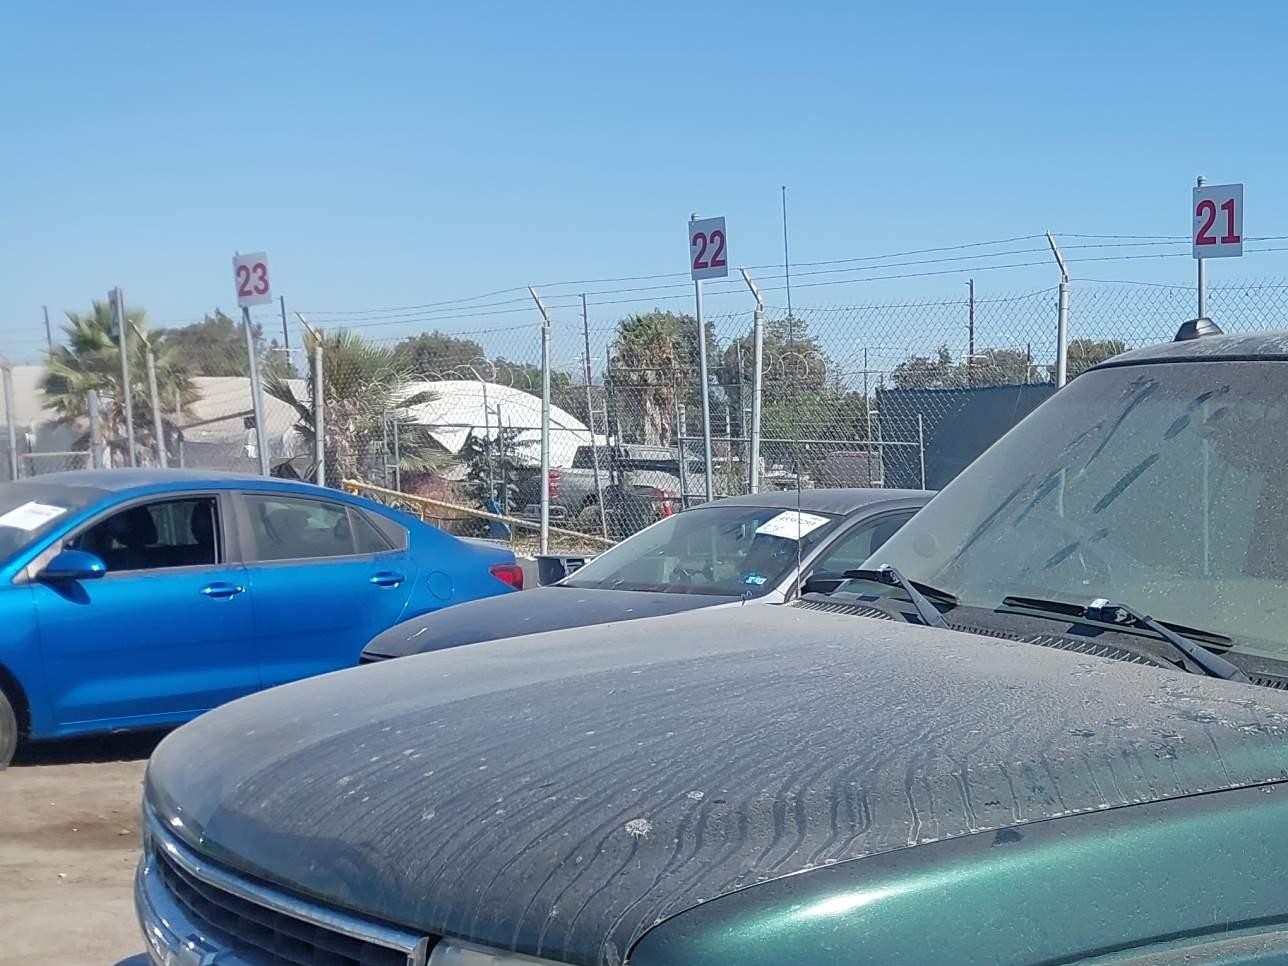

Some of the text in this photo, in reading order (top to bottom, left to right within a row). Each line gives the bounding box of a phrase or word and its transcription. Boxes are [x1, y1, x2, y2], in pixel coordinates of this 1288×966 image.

[1195, 198, 1241, 246] 21
[692, 229, 726, 270] 22
[236, 261, 269, 297] 23
